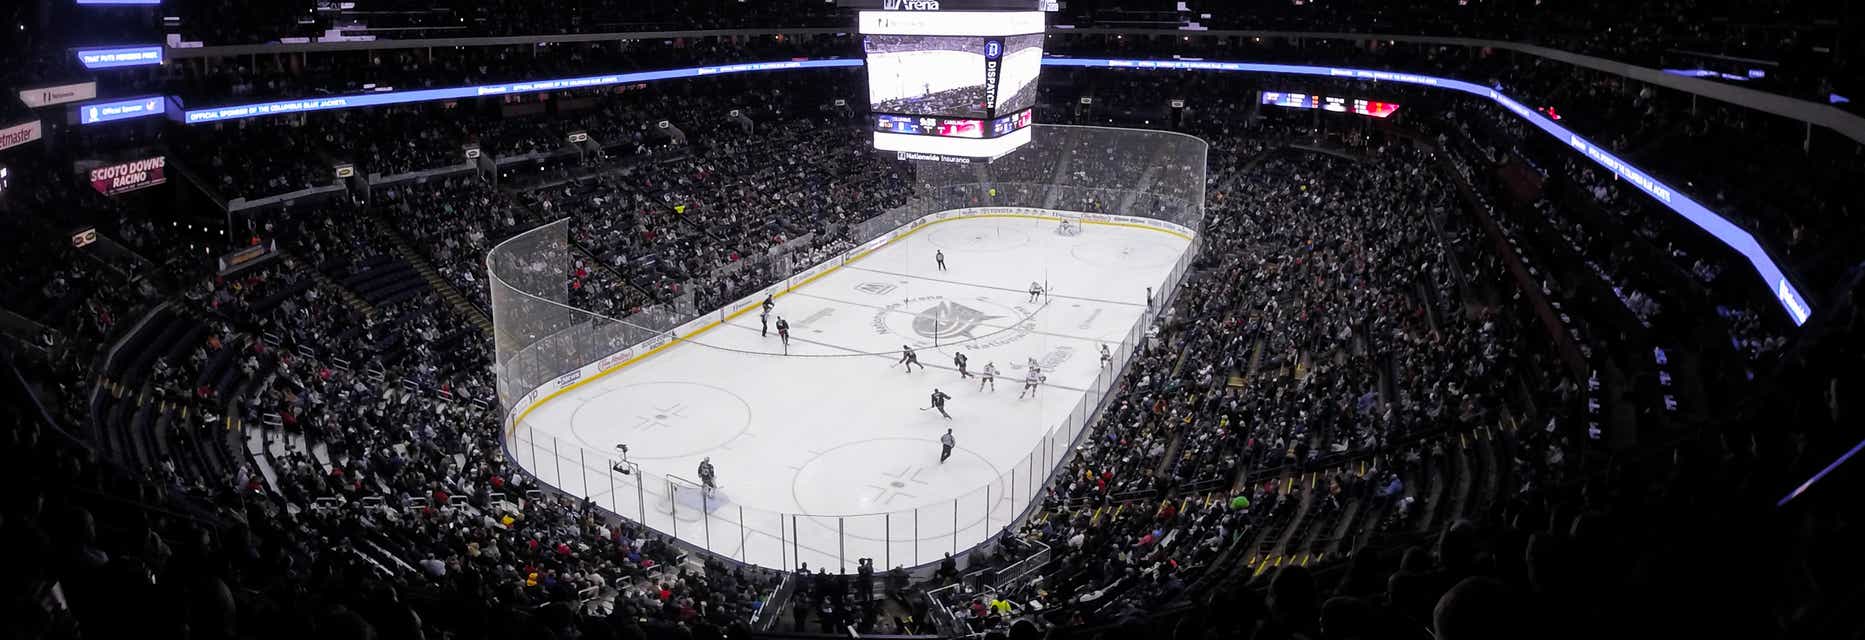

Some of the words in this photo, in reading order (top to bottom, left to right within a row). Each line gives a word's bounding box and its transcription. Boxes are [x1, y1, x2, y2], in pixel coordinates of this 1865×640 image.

[986, 61, 997, 108] DISPATCH
[190, 112, 218, 120] OFFICIAL
[906, 152, 940, 162] Nationwide
[940, 155, 970, 164] Insurance
[90, 164, 128, 182] SCIOTO
[129, 156, 165, 172] DOWNS
[113, 172, 146, 188] RACINO
